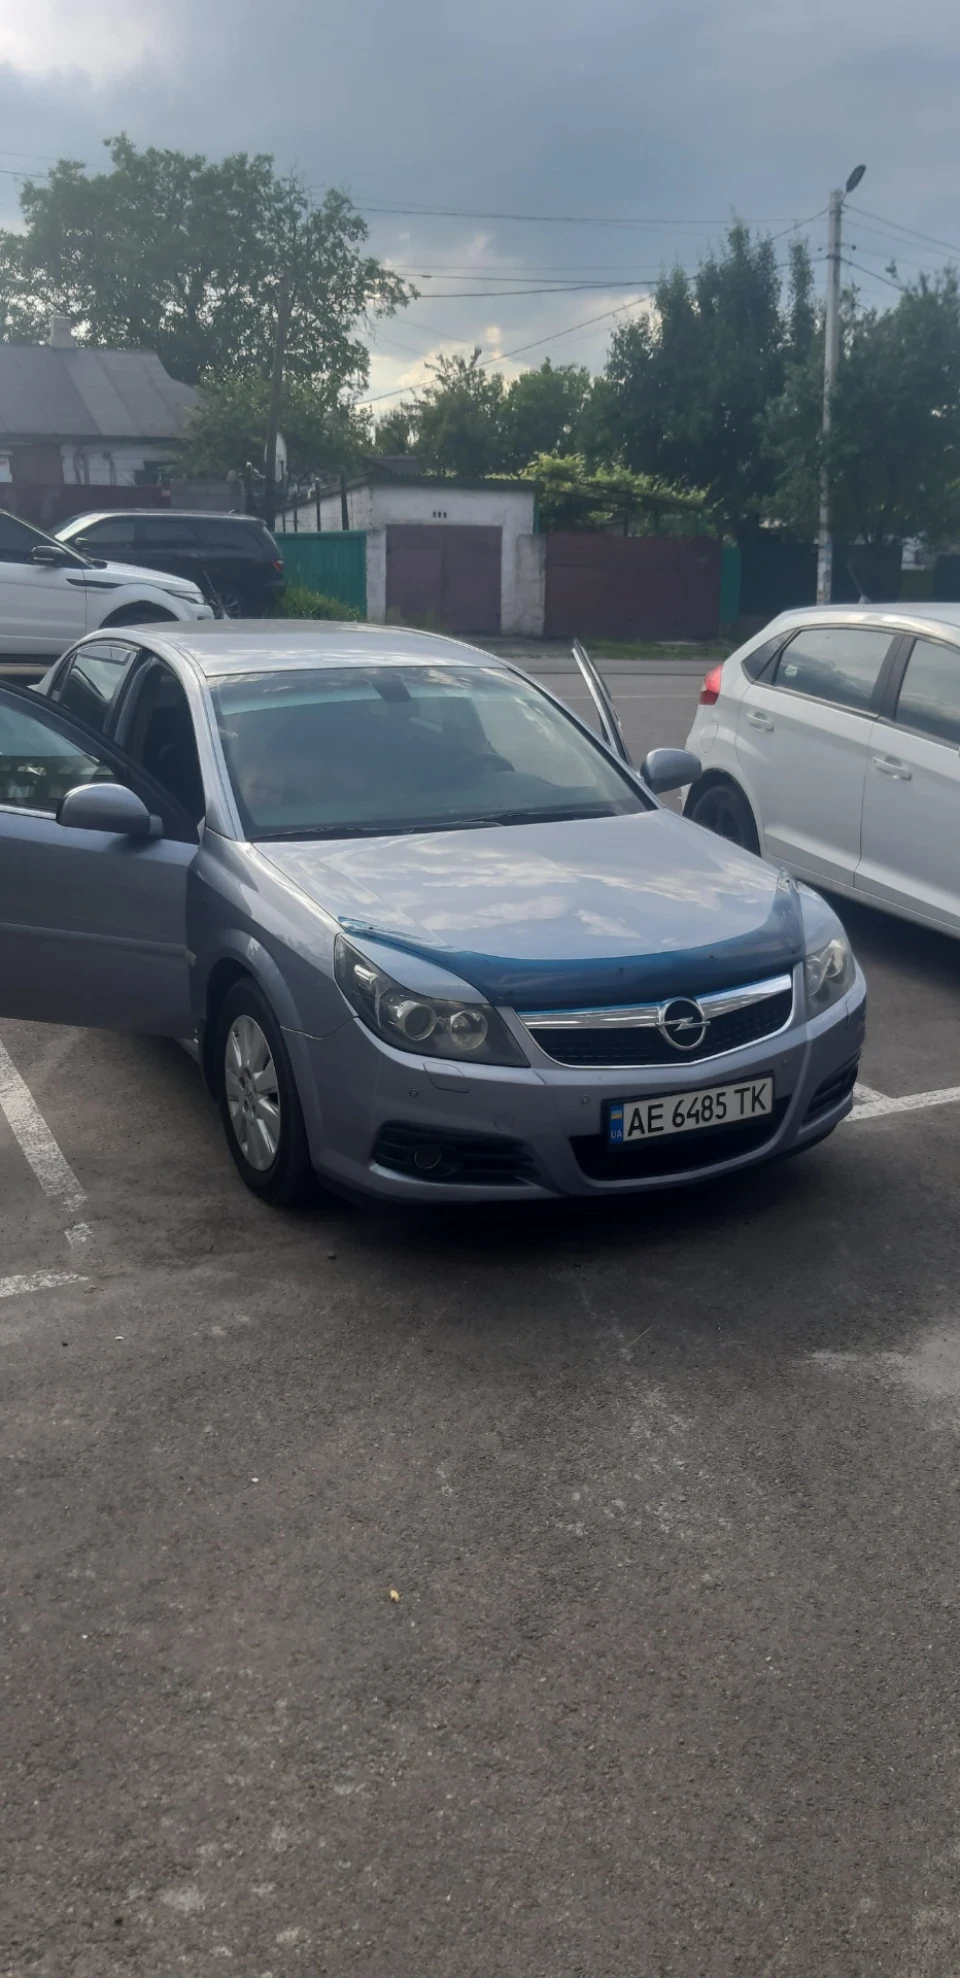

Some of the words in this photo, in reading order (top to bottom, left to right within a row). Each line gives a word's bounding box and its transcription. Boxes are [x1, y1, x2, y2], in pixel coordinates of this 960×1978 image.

[628, 1104, 664, 1136] AE
[672, 1092, 727, 1127] 6485
[734, 1083, 767, 1115] TK
[611, 1129, 622, 1139] UA
